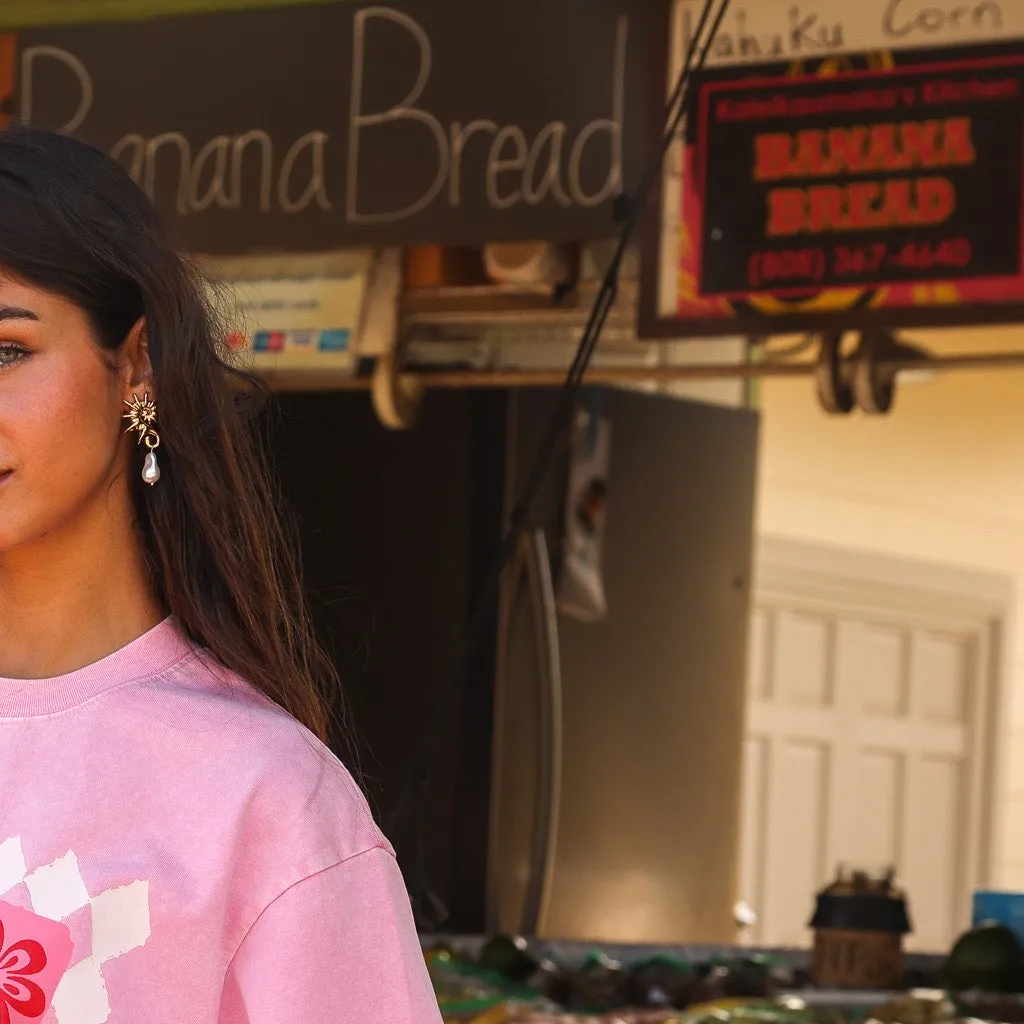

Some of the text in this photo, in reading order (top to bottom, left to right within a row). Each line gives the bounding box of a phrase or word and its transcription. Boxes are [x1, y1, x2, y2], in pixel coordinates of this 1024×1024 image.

[881, 0, 1003, 37] Corn
[346, 6, 628, 224] Bread
[753, 117, 975, 182] BANANA
[765, 177, 956, 237] BREAD
